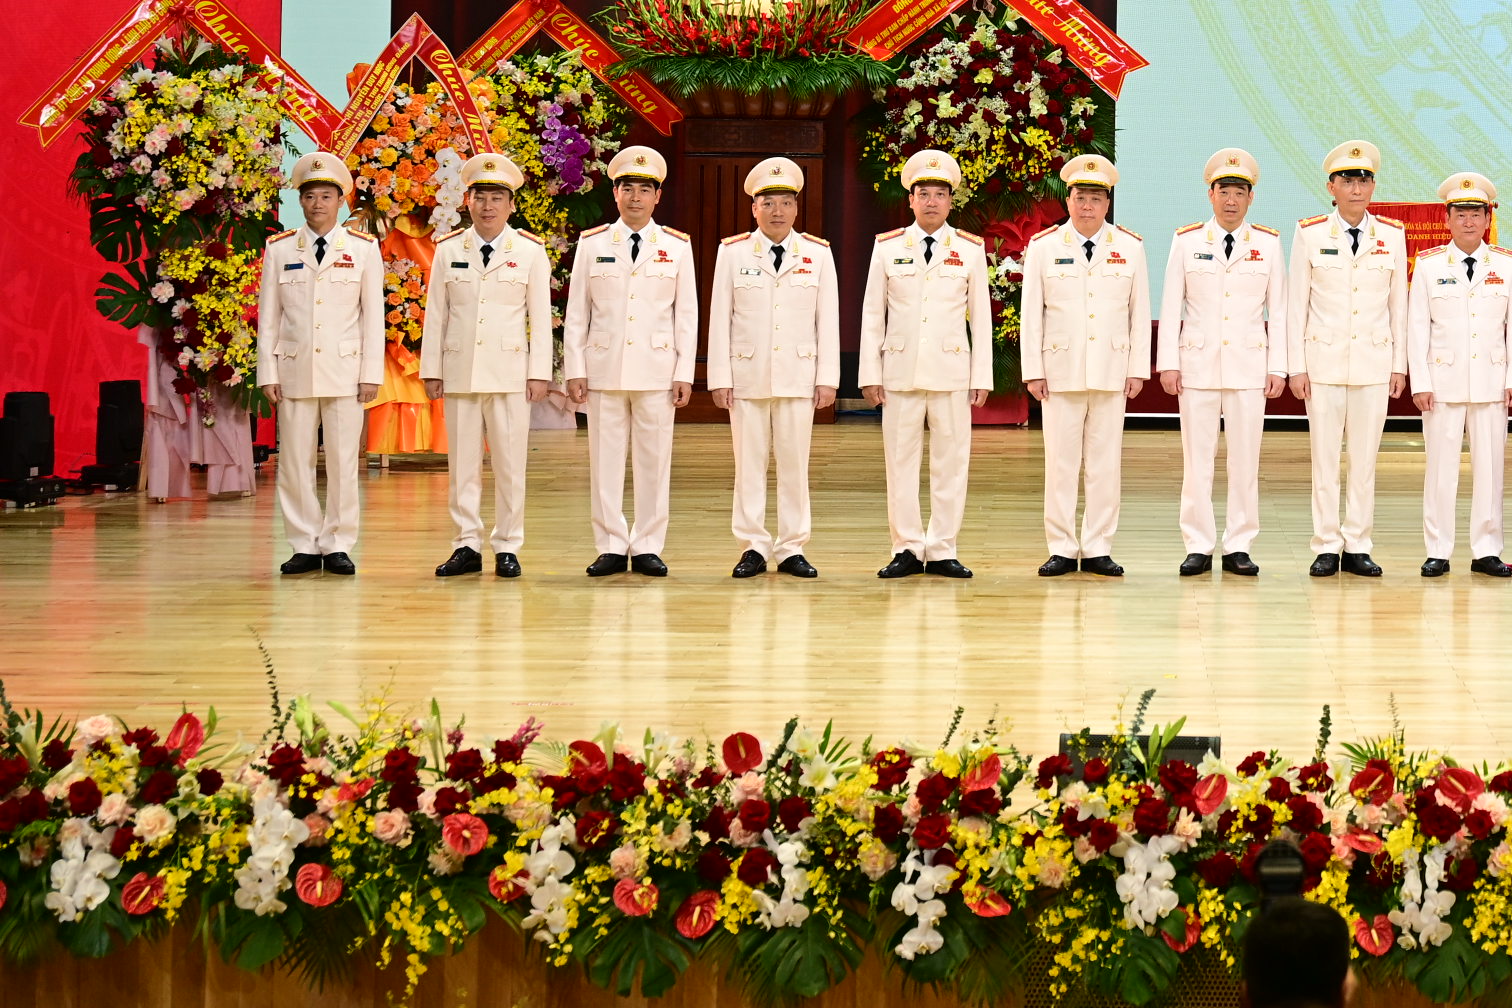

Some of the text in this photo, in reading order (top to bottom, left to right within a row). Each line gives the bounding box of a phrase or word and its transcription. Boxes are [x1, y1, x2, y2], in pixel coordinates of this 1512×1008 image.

[194, 0, 250, 56] Chúc
[525, 17, 536, 28] VIỆT
[533, 9, 545, 20] NAM
[551, 13, 599, 57] Chúc
[1053, 16, 1112, 68] Mừng
[86, 57, 111, 81] TRUNG
[349, 60, 385, 111] NGUYỄN DUY NGỌC
[430, 45, 471, 105] Chúc
[334, 139, 345, 151] BỘ
[363, 97, 372, 106] BÍ
[368, 85, 380, 99] THƯ
[395, 41, 411, 59] ĐẢNG
[355, 117, 368, 133] BAN
[369, 93, 384, 110] CHỨC
